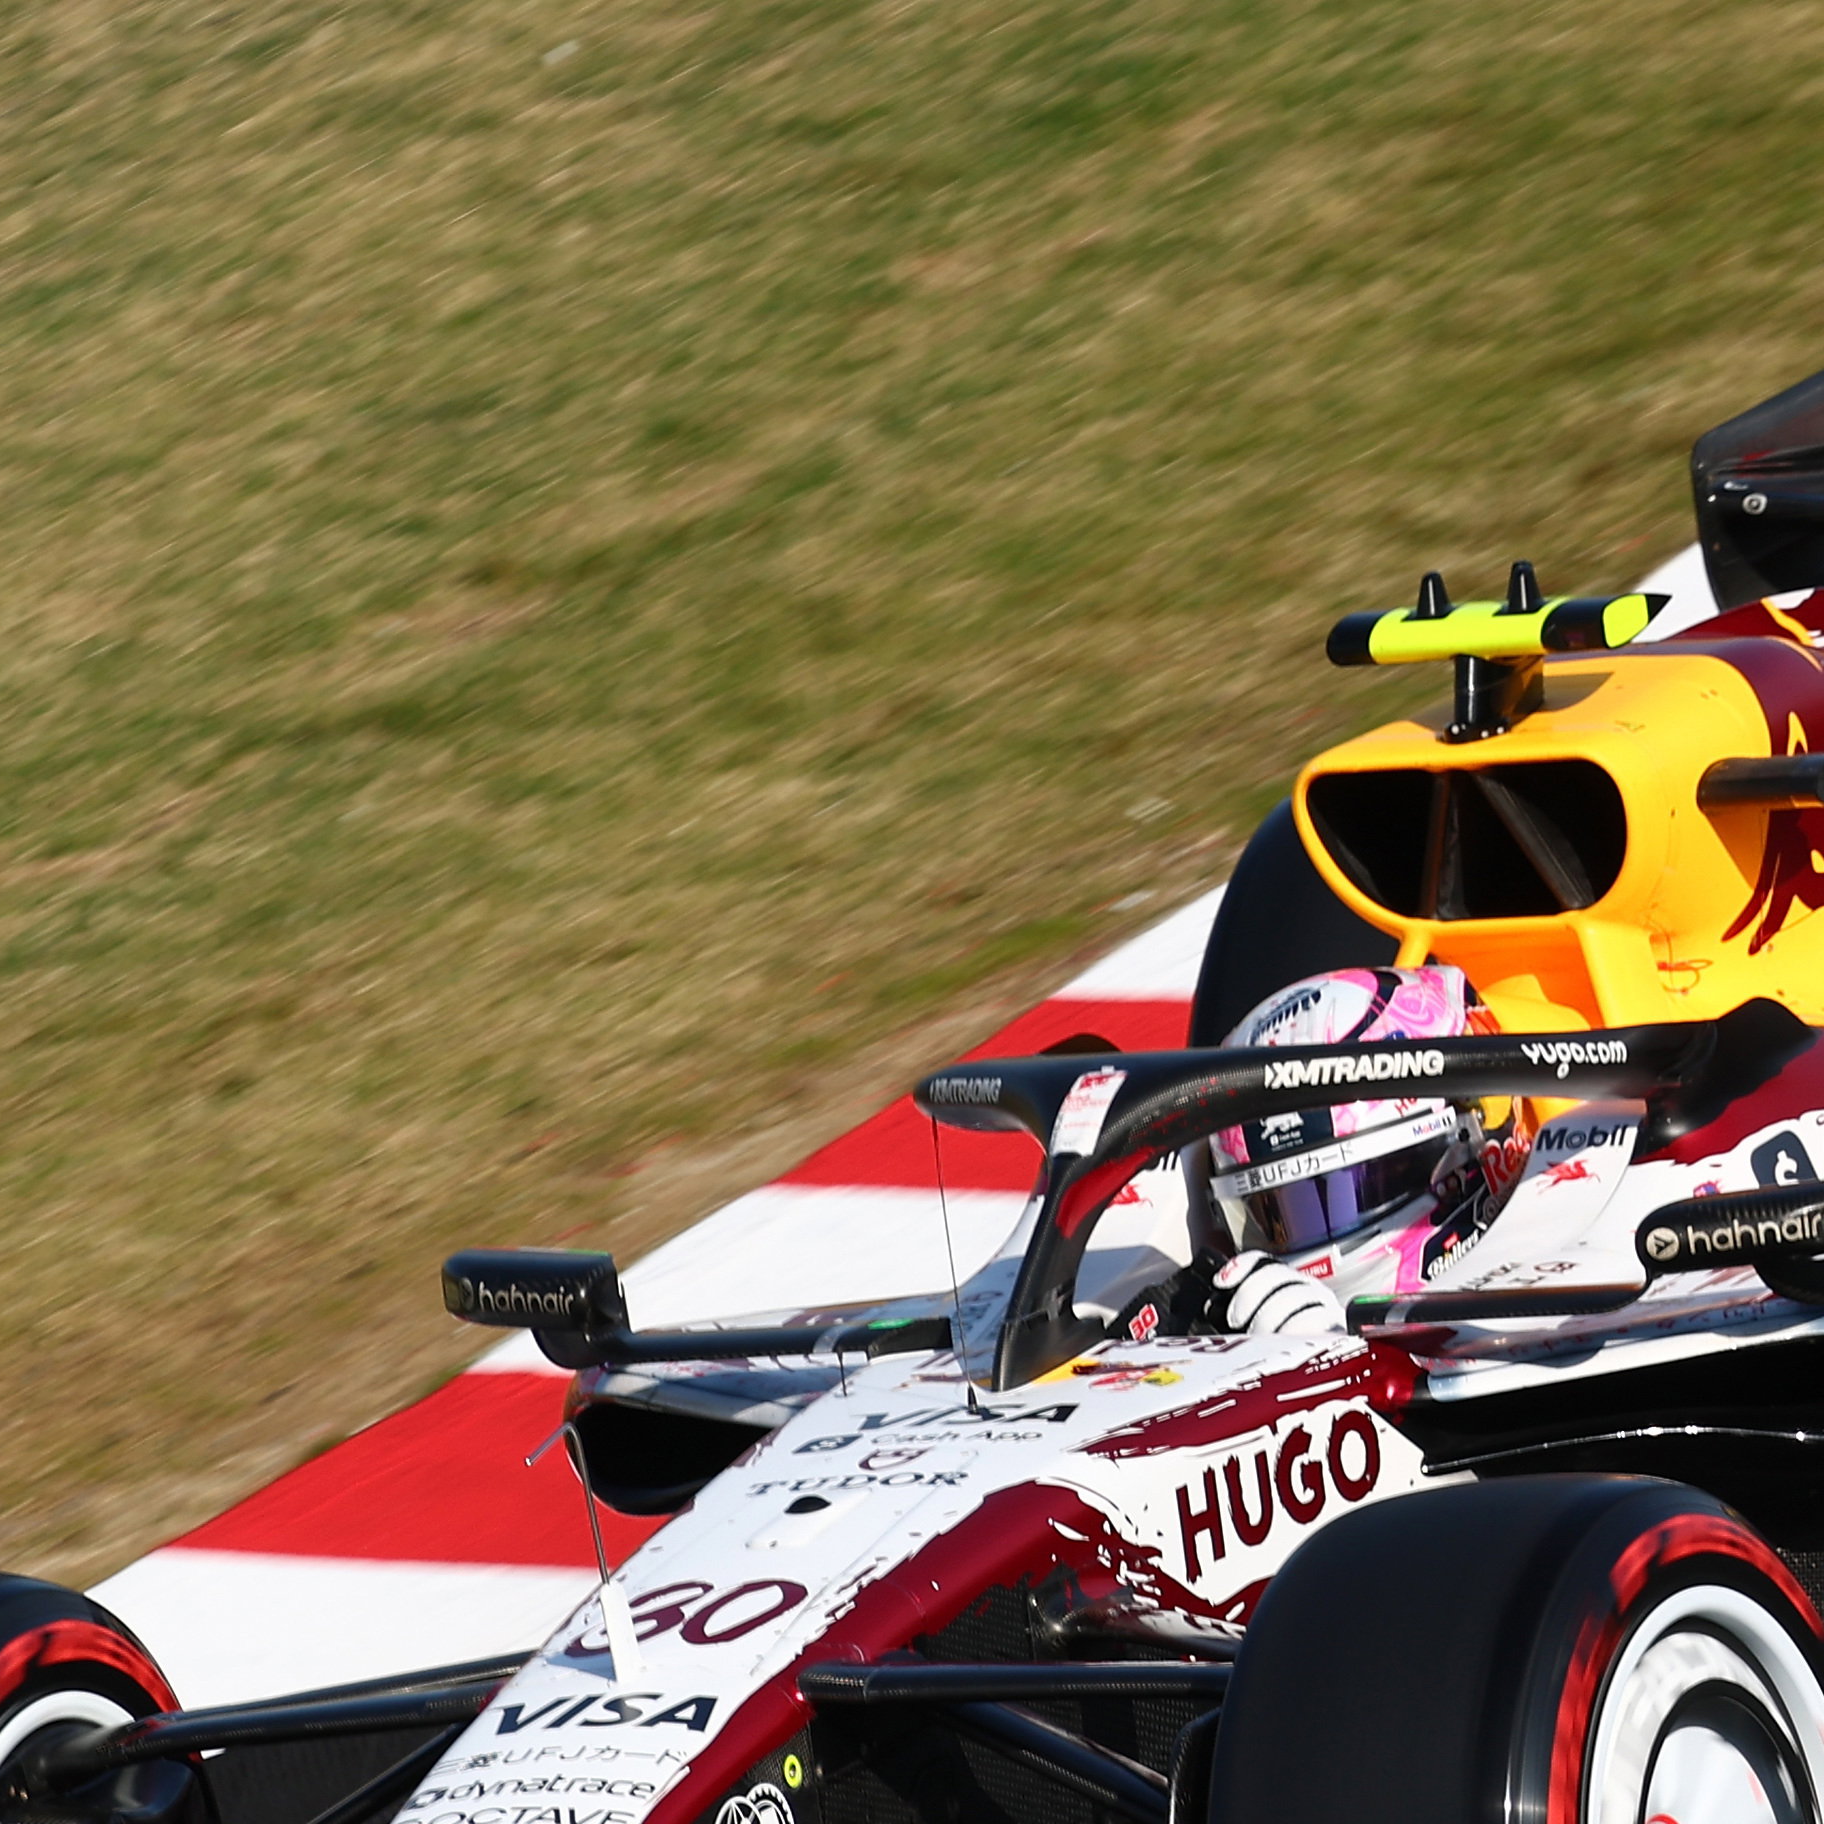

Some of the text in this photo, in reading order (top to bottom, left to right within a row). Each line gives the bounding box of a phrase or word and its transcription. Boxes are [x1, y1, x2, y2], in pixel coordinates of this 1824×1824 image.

[1272, 1049, 1445, 1089] XMTRADING
[1521, 1041, 1629, 1079] yugo.com
[1536, 1124, 1628, 1151] Mobil
[1687, 1210, 1822, 1255] hahnair
[478, 1281, 574, 1315] hahnair
[859, 1403, 1080, 1431] VISA
[872, 1429, 1044, 1445] Cash App
[749, 1470, 970, 1498] TUDOR
[1176, 1407, 1381, 1584] HUGO
[564, 1579, 809, 1659] 30
[492, 1693, 719, 1736] VISA
[449, 1773, 656, 1800] dynatrace
